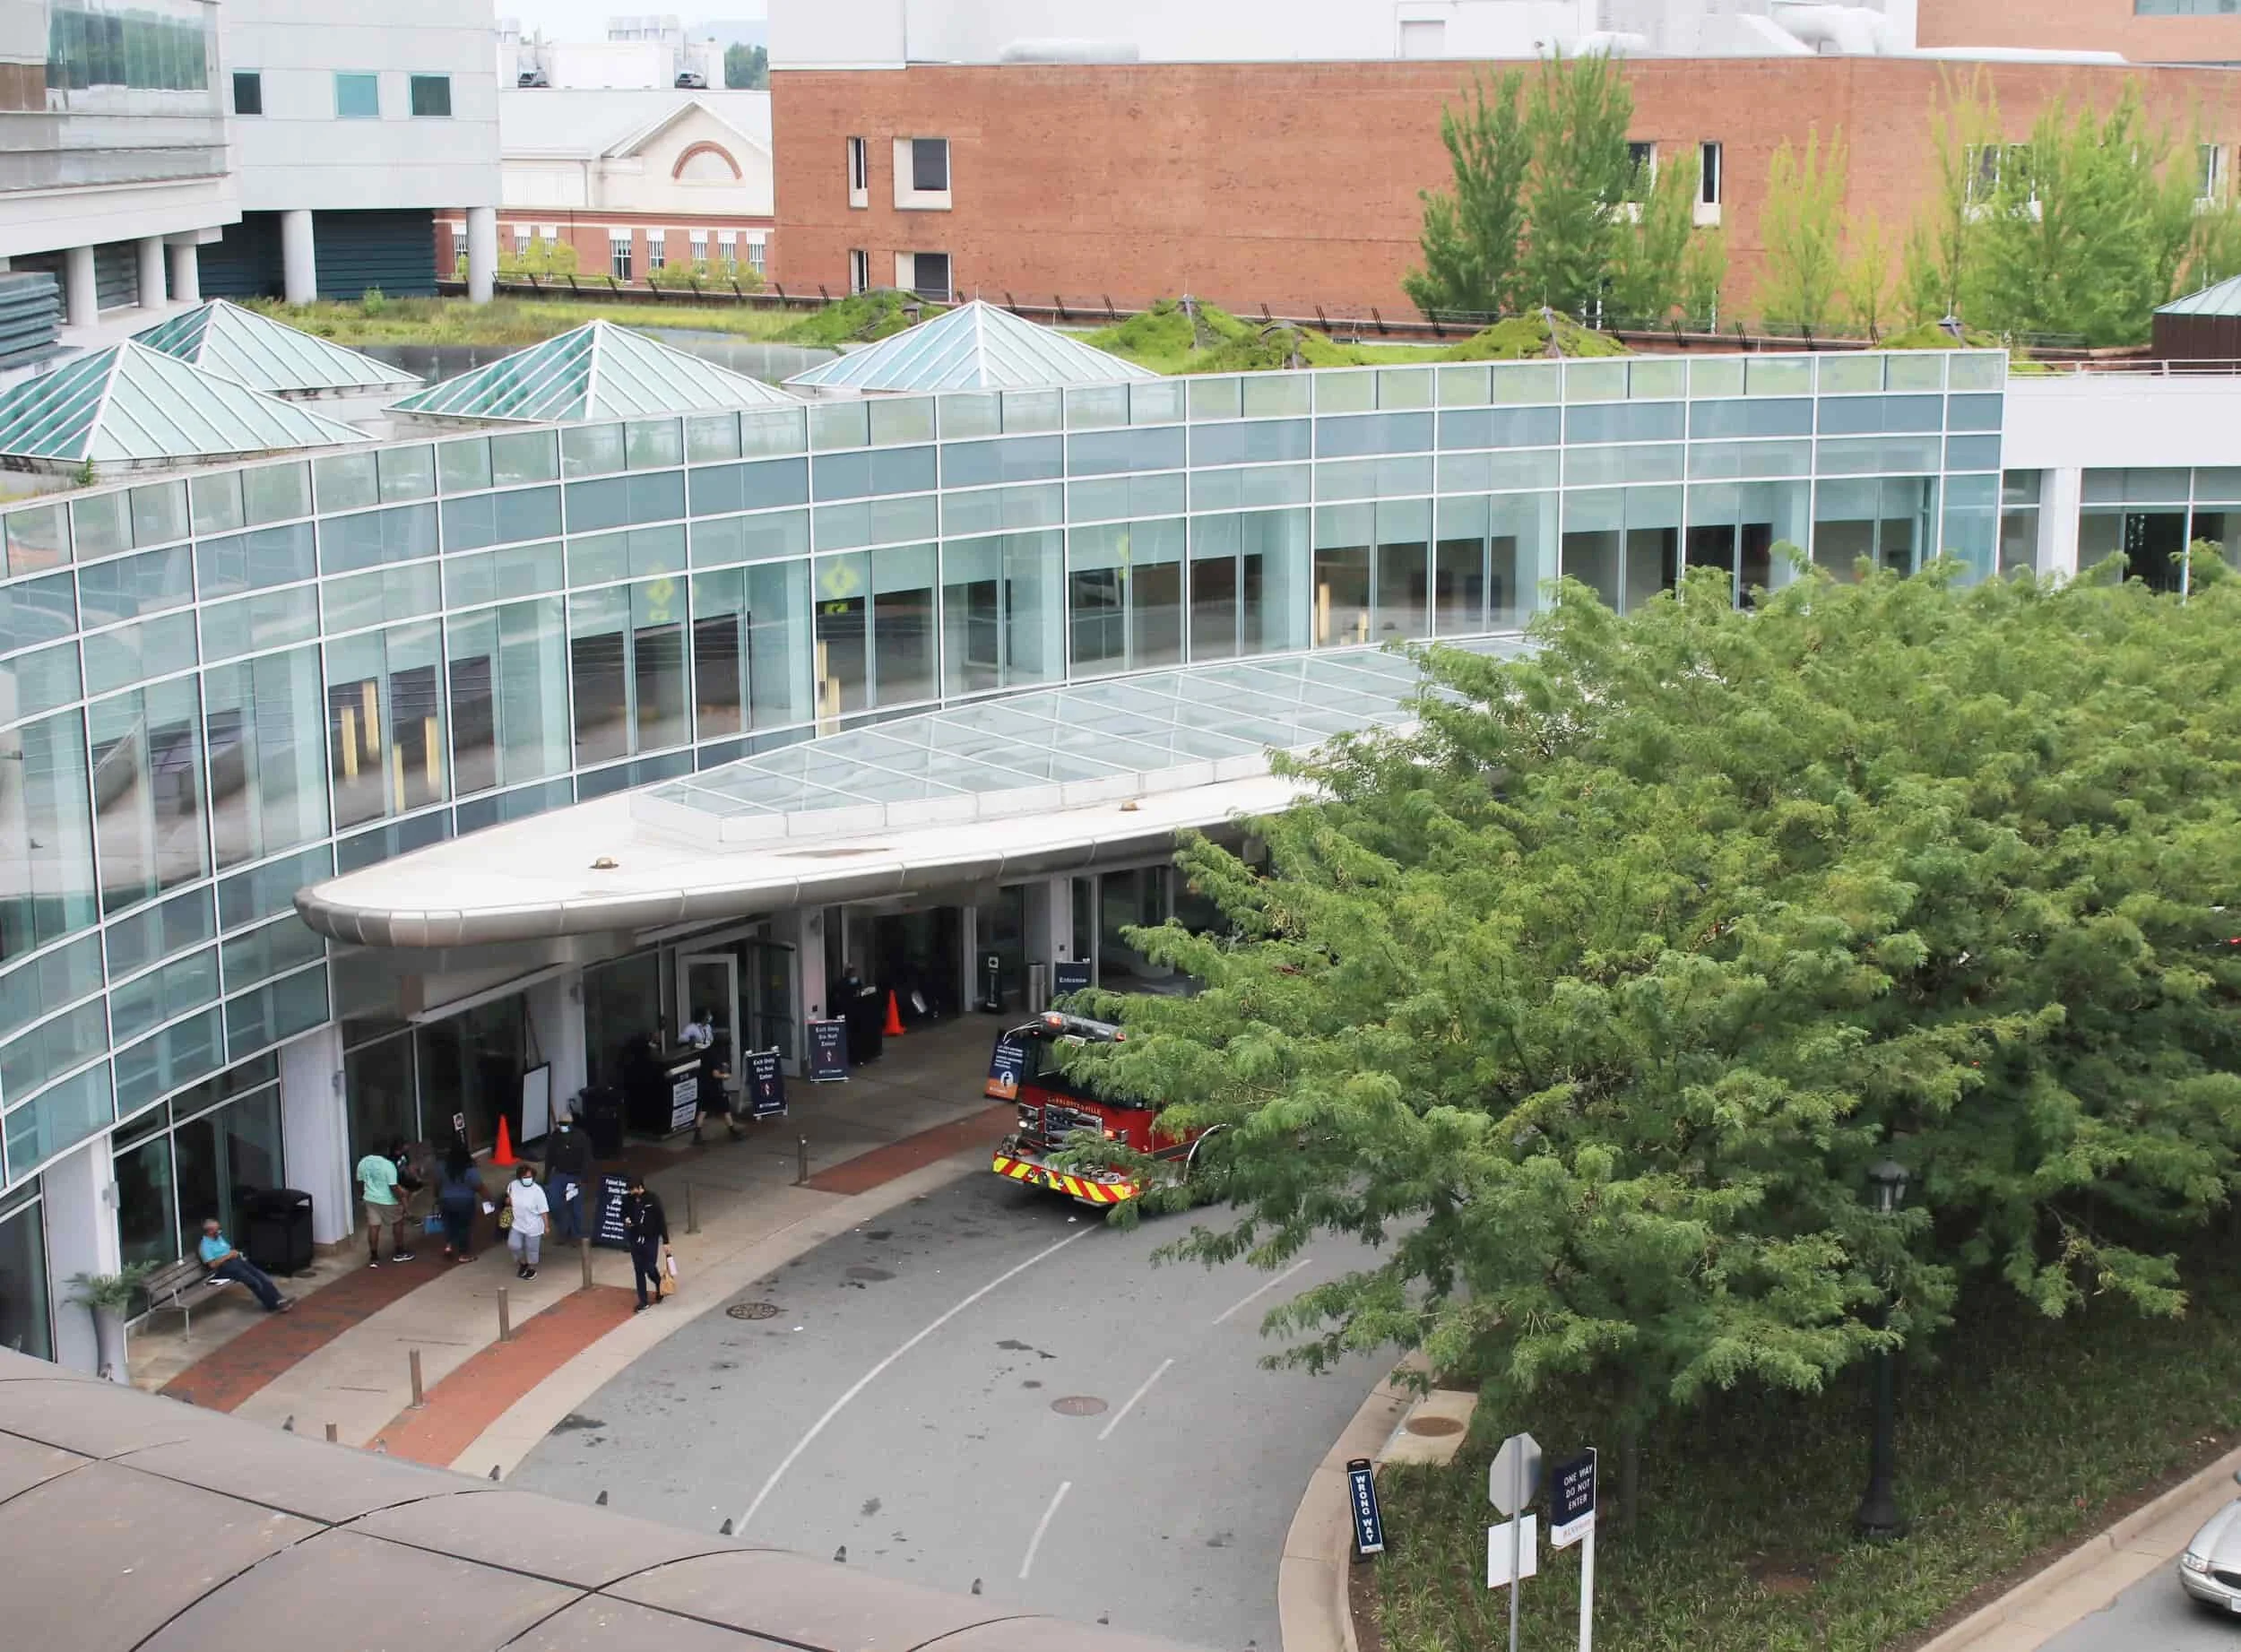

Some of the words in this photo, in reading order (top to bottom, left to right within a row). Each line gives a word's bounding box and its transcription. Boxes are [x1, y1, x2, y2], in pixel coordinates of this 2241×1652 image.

[1563, 1472, 1578, 1486] ONE
[1579, 1464, 1593, 1478] WAY
[1565, 1488, 1576, 1499] DO
[1578, 1479, 1590, 1492] NOT
[1355, 1475, 1371, 1516] WRONG
[1363, 1518, 1374, 1543] WAY
[1568, 1493, 1588, 1510] ENTER
